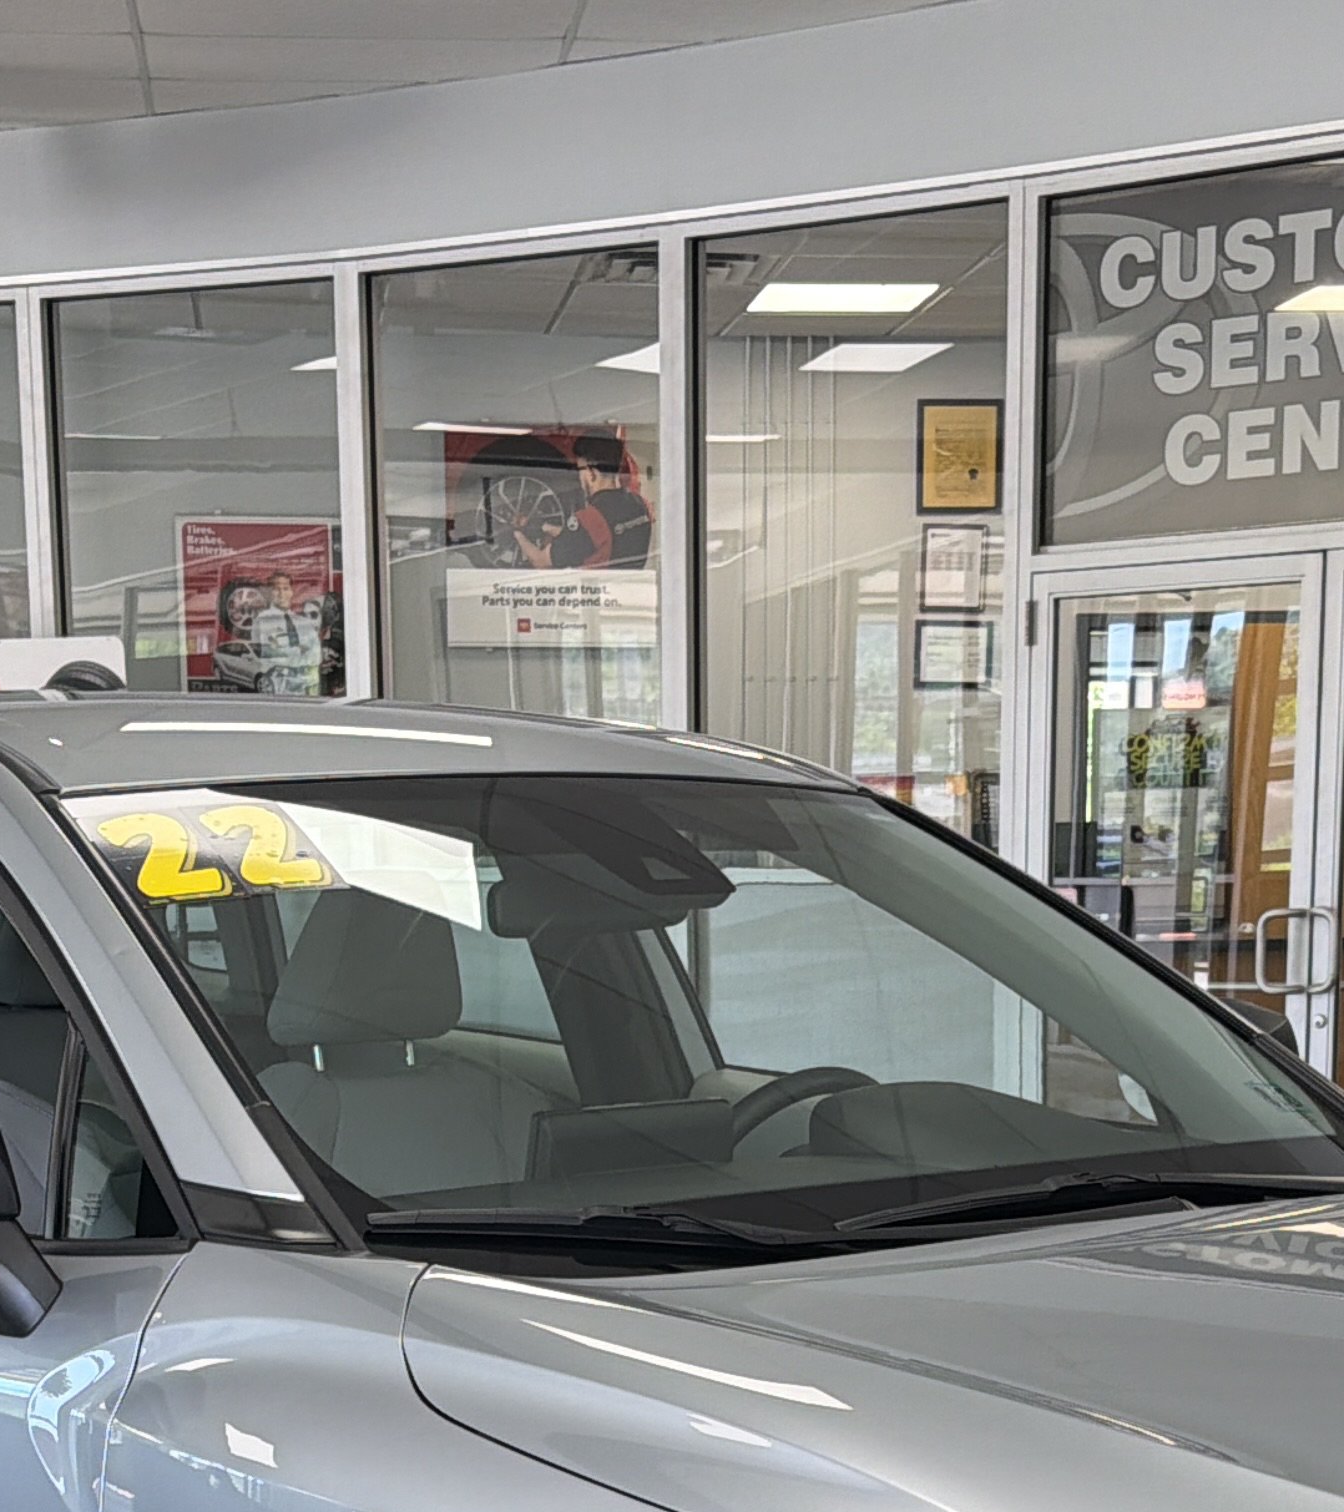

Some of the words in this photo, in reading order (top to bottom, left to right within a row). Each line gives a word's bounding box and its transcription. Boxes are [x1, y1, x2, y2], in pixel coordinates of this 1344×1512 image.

[493, 583, 532, 595] Service
[535, 587, 555, 597] you
[558, 586, 577, 595] can
[581, 585, 610, 595] trust.
[482, 596, 510, 606] Parts
[513, 598, 533, 609] you
[536, 598, 555, 607] can
[558, 596, 601, 609] depend
[97, 805, 332, 902] 22
